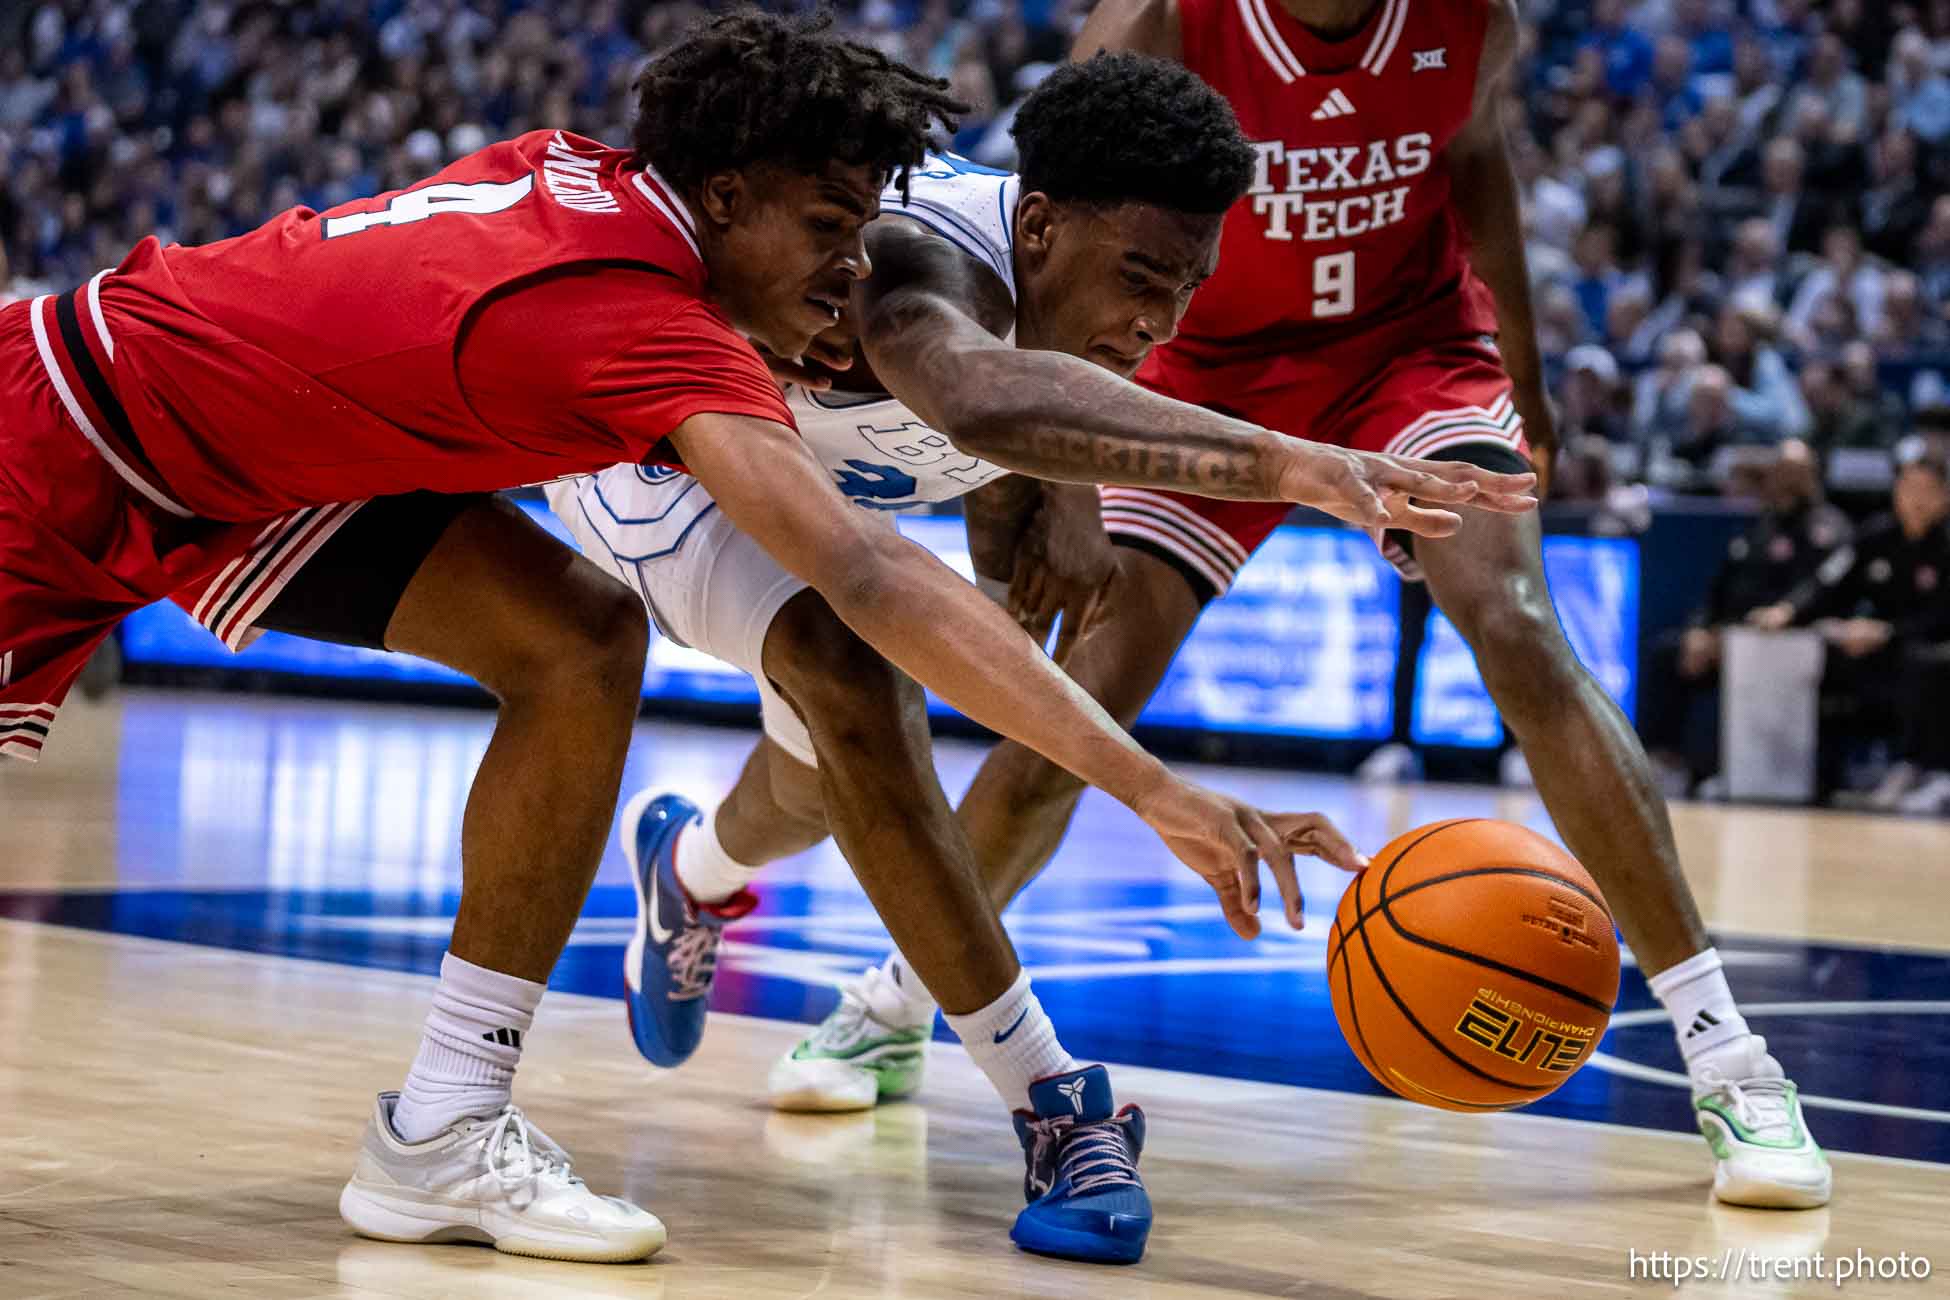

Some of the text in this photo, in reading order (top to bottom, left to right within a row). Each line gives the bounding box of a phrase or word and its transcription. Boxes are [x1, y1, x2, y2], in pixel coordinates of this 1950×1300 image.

[1412, 48, 1447, 72] XII
[1249, 132, 1432, 194] TEXAS
[321, 171, 536, 240] 4
[1254, 187, 1410, 241] TECH
[1312, 250, 1356, 317] 9
[1454, 996, 1590, 1072] ELITE
[1477, 987, 1595, 1037] CHAMPIONSHIP
